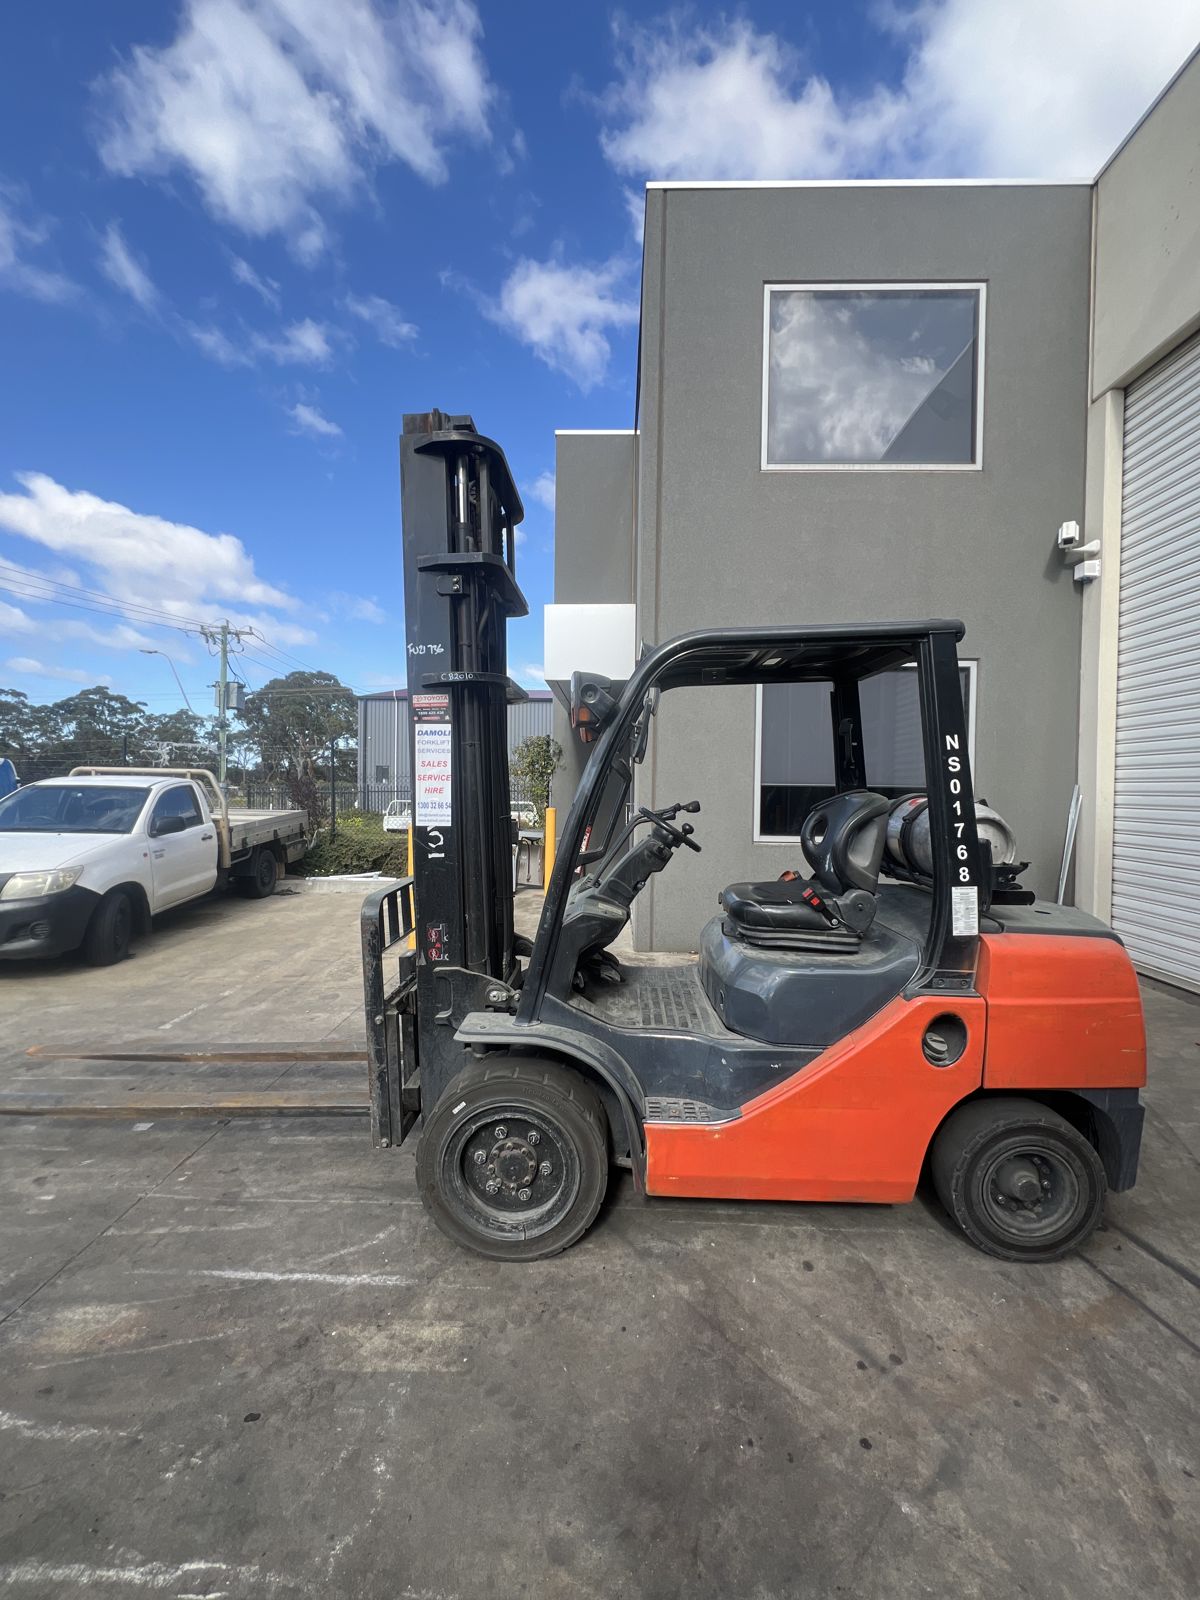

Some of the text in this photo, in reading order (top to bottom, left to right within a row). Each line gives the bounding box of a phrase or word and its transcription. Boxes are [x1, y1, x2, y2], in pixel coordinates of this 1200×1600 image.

[420, 760, 448, 768] SALES
[417, 774, 452, 782] SERVICE
[430, 801, 437, 809] 32
[945, 734, 970, 882] NS01768
